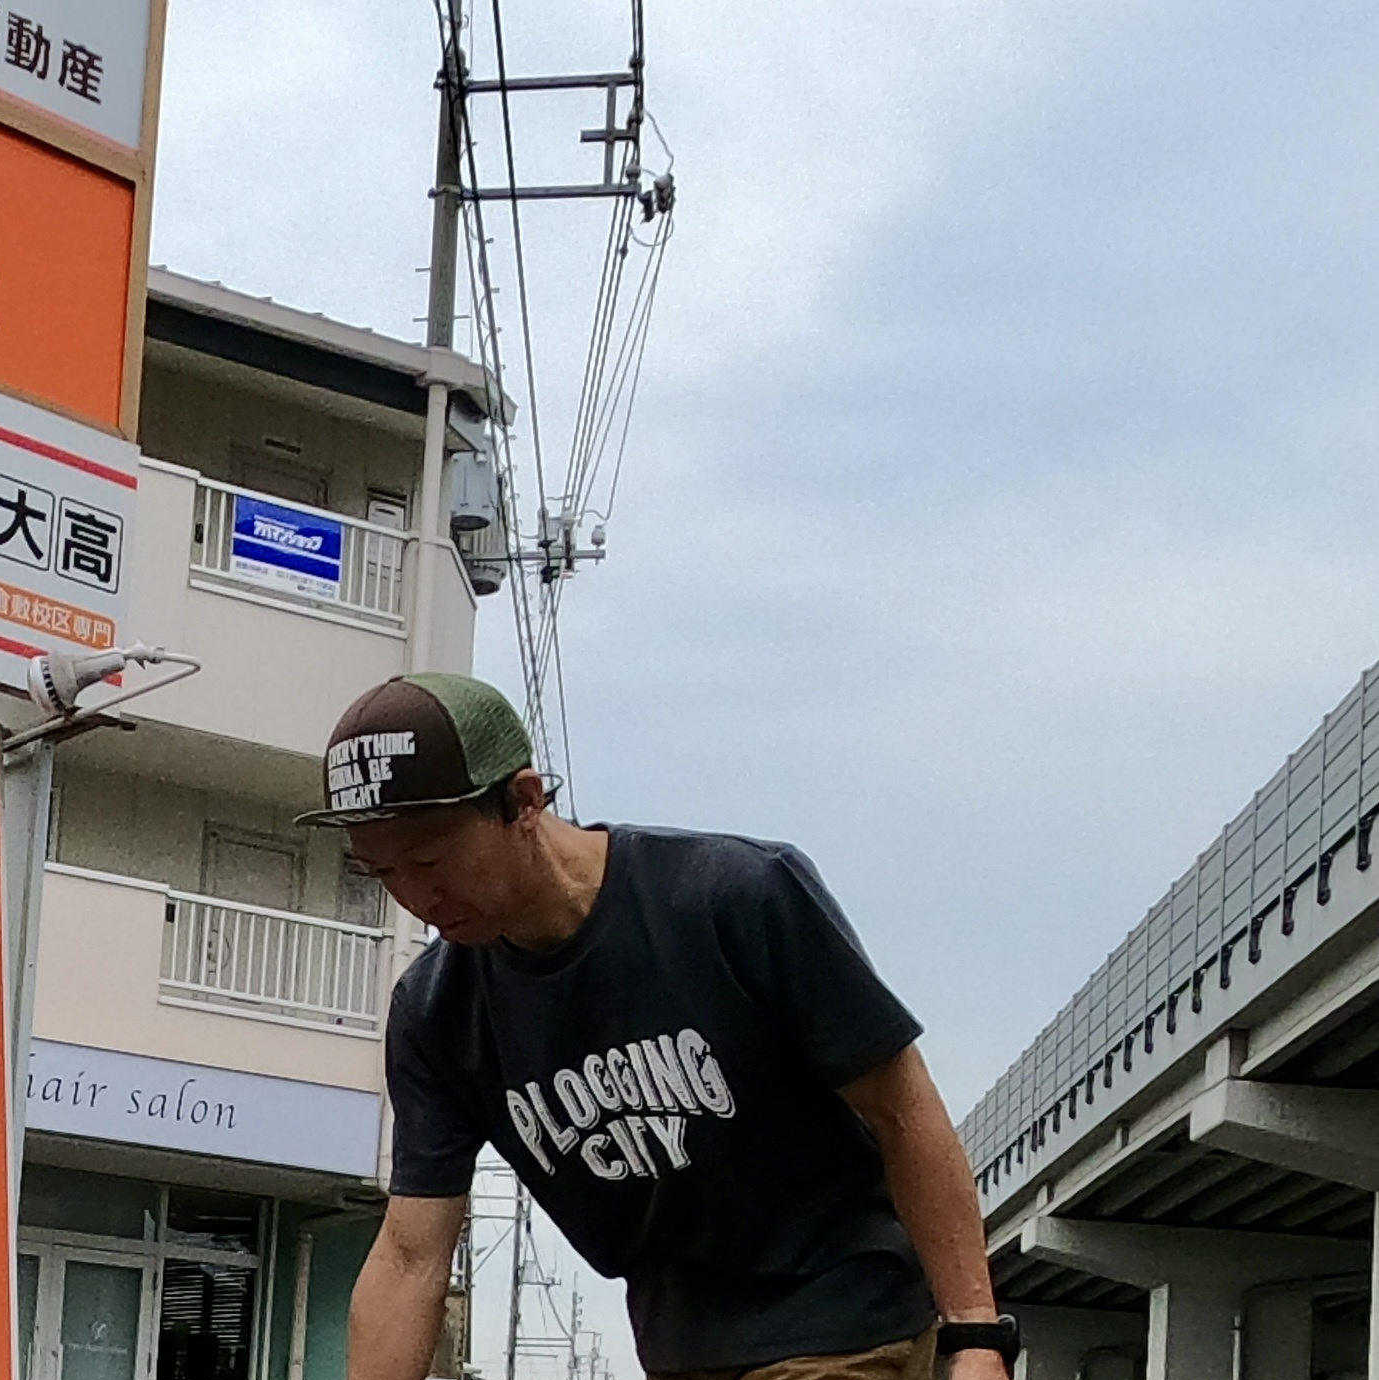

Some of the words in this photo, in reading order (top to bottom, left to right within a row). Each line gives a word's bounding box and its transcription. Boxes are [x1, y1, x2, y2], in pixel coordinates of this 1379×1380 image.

[368, 757, 393, 782] BE
[127, 1078, 237, 1129] salon
[506, 1028, 736, 1177] PLOGGING
[580, 1115, 692, 1180] CITY
